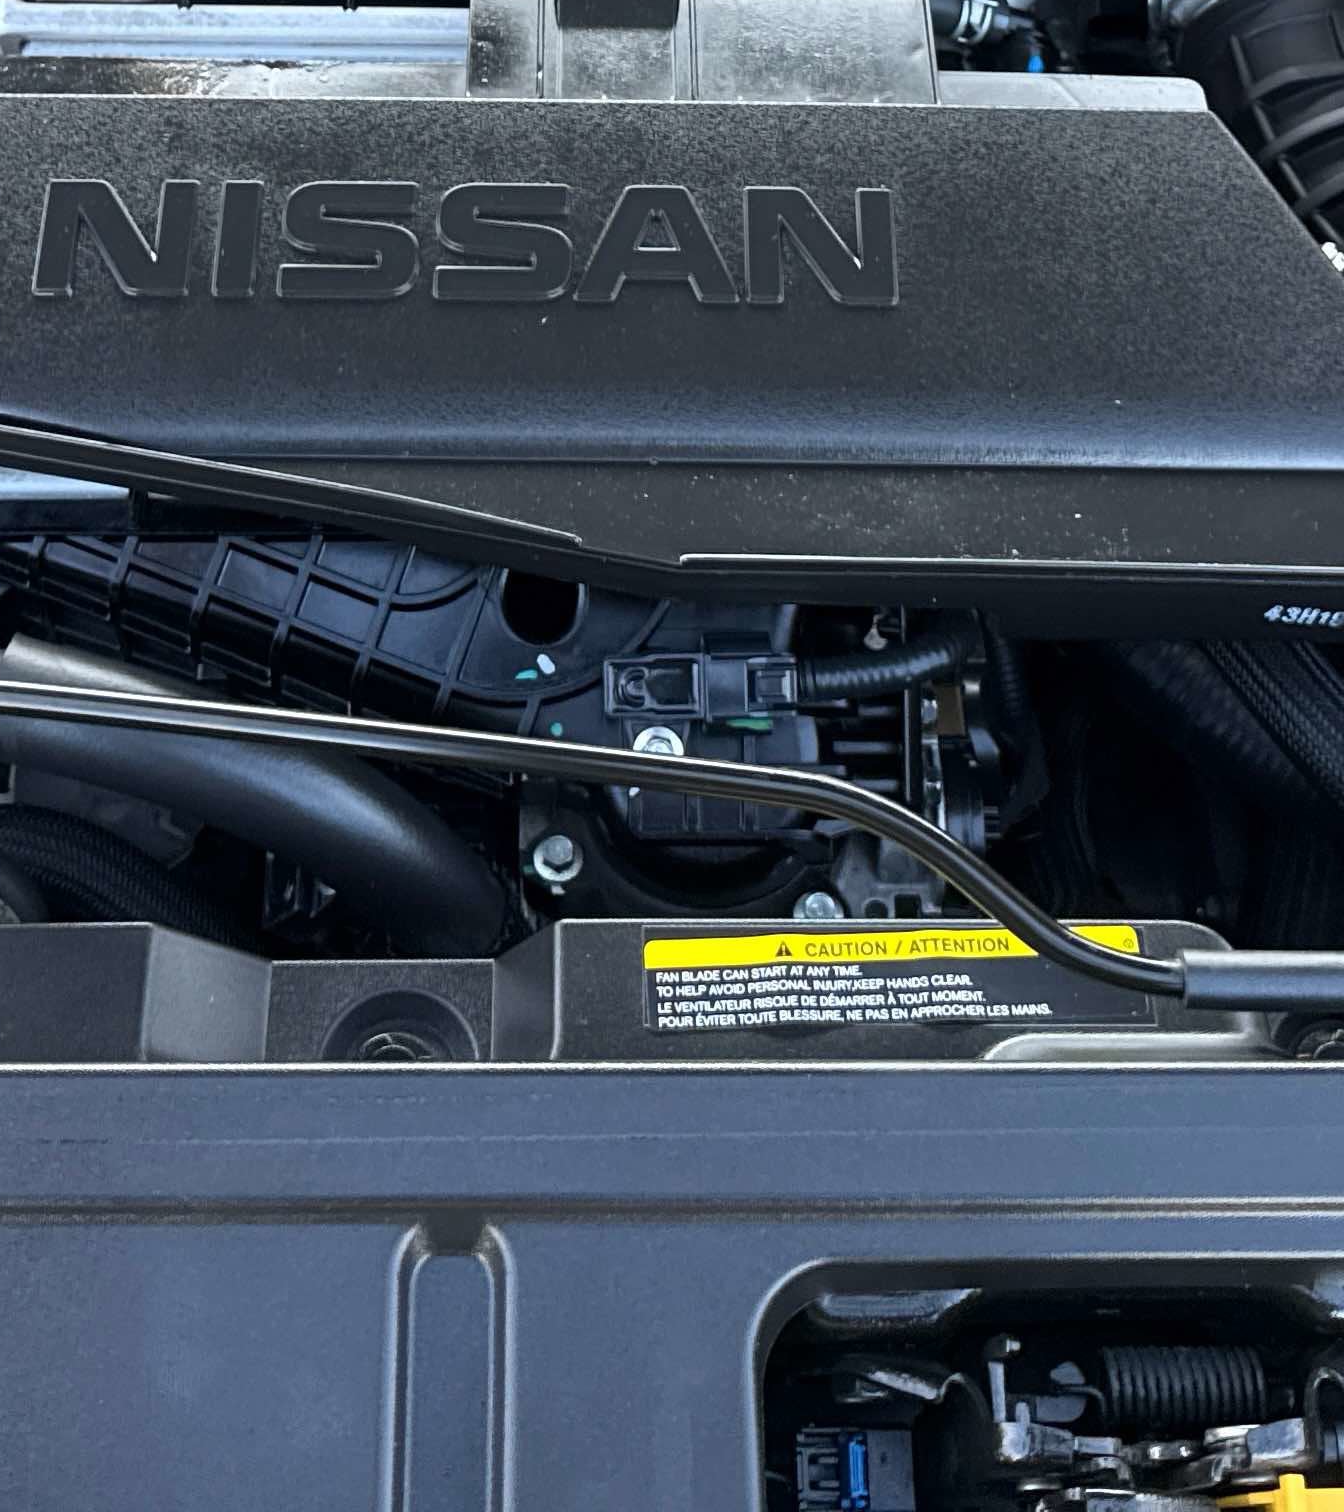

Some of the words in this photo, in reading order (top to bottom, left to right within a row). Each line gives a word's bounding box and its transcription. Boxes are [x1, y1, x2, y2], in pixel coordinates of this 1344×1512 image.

[31, 178, 900, 306] NISSAN
[805, 942, 887, 957] CAUTION
[895, 940, 903, 955] /
[909, 937, 1010, 954] ATTENTION
[656, 971, 679, 983] FAN
[682, 969, 721, 982] BLADE
[722, 969, 749, 981] CAN
[751, 966, 788, 979] START
[790, 965, 804, 976] AT
[806, 965, 830, 977] ANY
[832, 965, 862, 976] TIME.
[656, 985, 673, 998] TO
[676, 983, 707, 996] HELP
[709, 982, 744, 995] AVOID
[748, 979, 811, 994] PERSONAL
[886, 976, 929, 989] HANDS
[931, 974, 973, 986] CLEAR.
[658, 1002, 672, 1014] LE
[674, 998, 751, 1013] VENTILATEUR
[753, 995, 798, 1009] RISQUE
[801, 995, 817, 1006] DE
[820, 993, 884, 1006] DÉMARRER
[887, 991, 896, 1005] À
[898, 991, 929, 1005] TOUT
[932, 990, 986, 1002] MOMENT.
[658, 1015, 693, 1028] POUR
[696, 1012, 736, 1027] ÉVITER
[738, 1010, 777, 1025] TOUTE
[779, 1008, 844, 1023] BLESSURE,
[847, 1008, 863, 1020] NE
[865, 1007, 889, 1020] PAS
[891, 1007, 908, 1019] EN
[910, 1003, 985, 1018] APPROCHER
[987, 1004, 1009, 1016] LES
[1011, 1003, 1052, 1016] MAINS.
